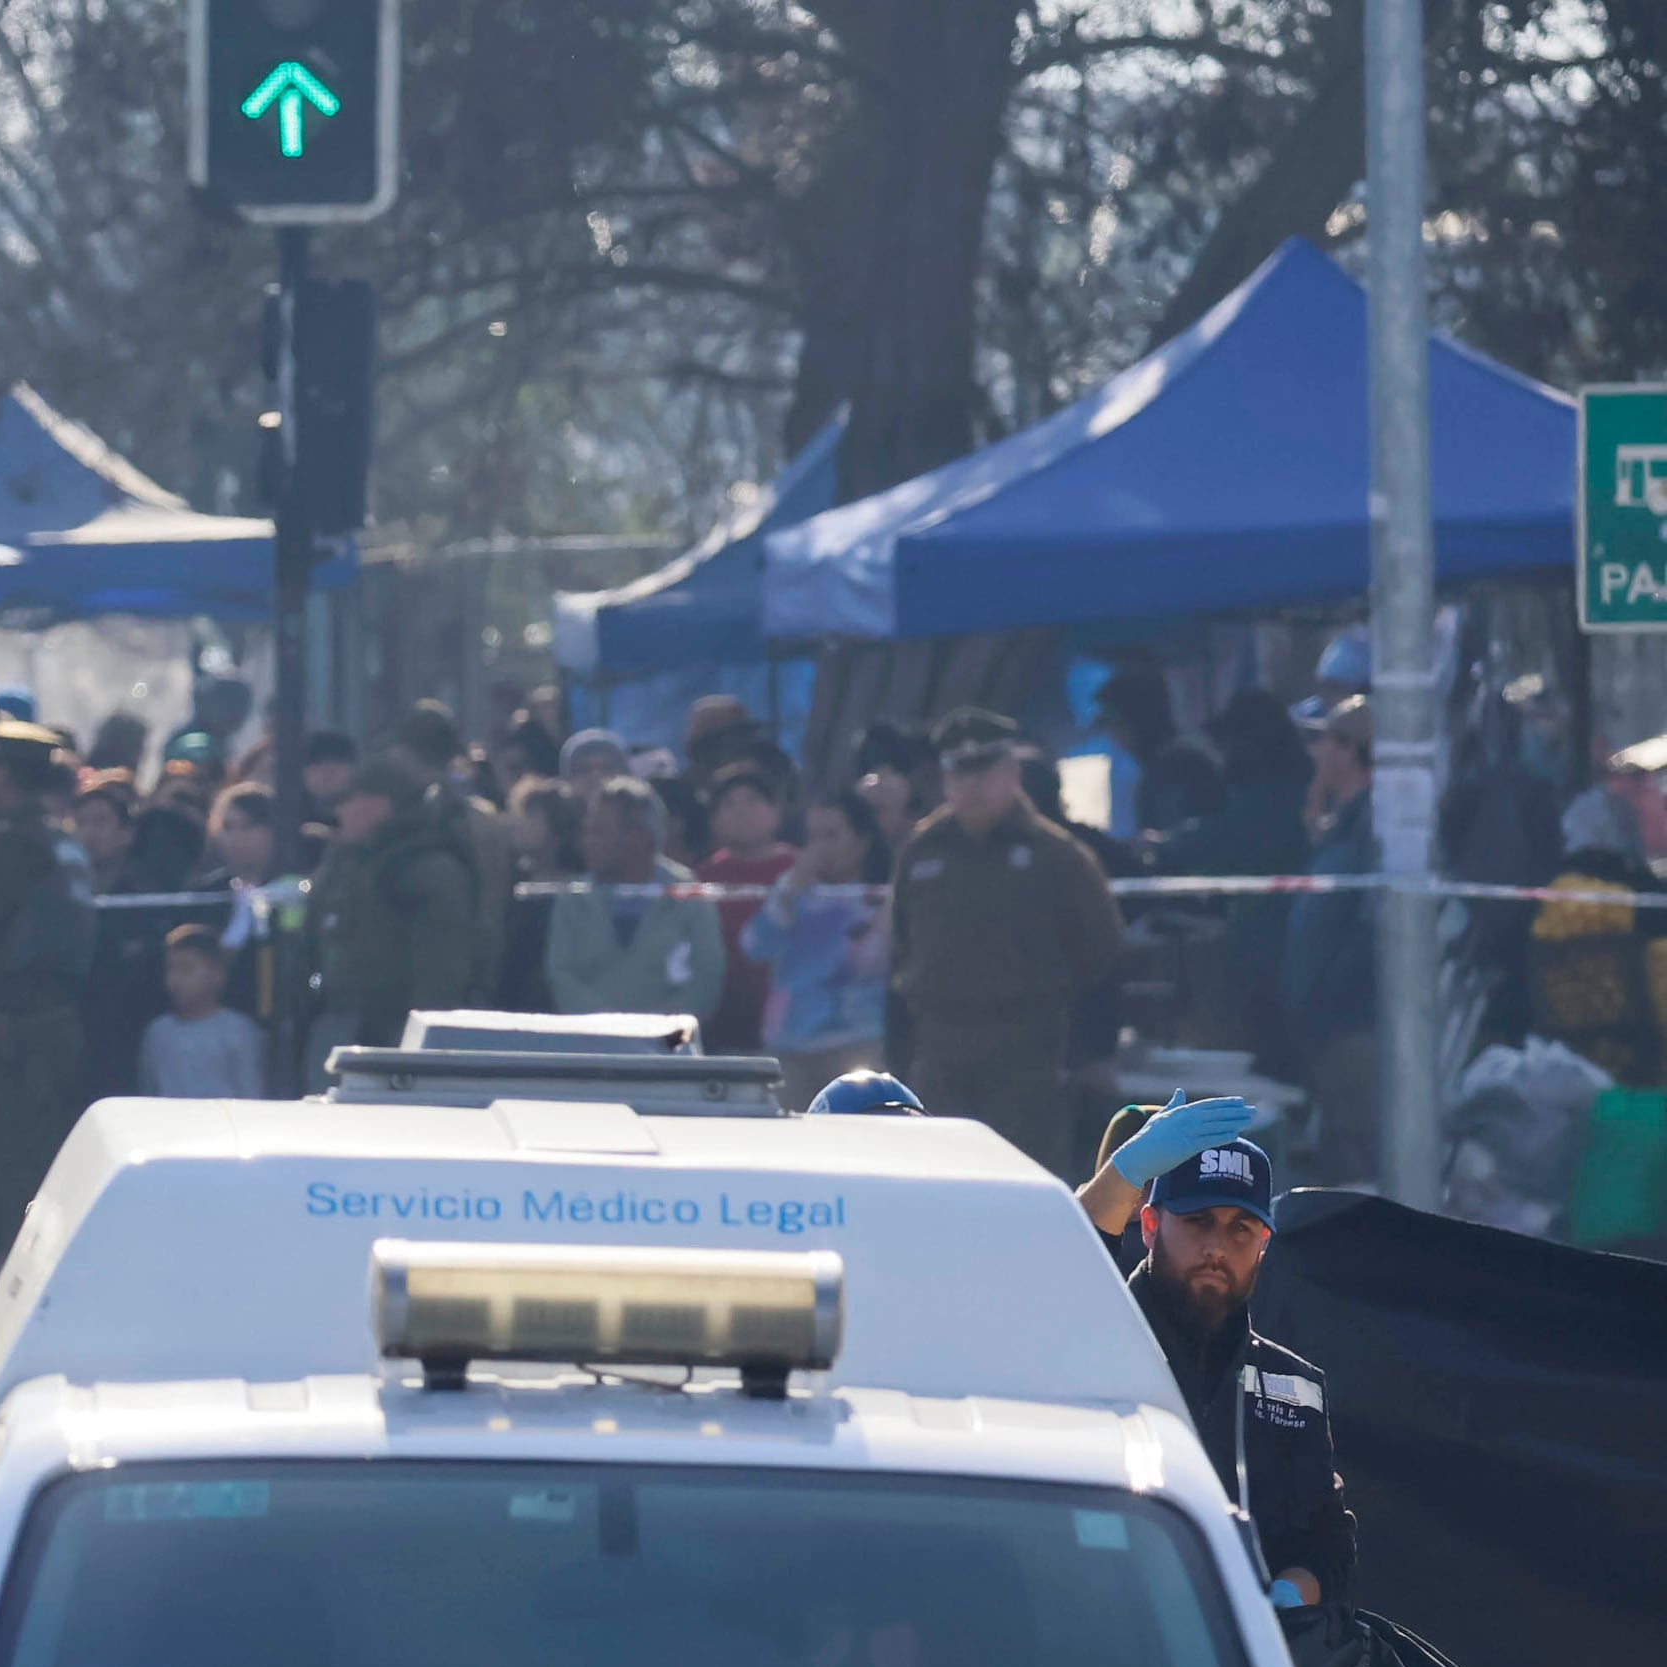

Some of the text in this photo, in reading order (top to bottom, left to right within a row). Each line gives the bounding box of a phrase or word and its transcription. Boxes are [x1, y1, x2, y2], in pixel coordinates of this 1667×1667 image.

[1199, 1149, 1254, 1181] SML
[305, 1181, 845, 1234] Servicio Médico Legal
